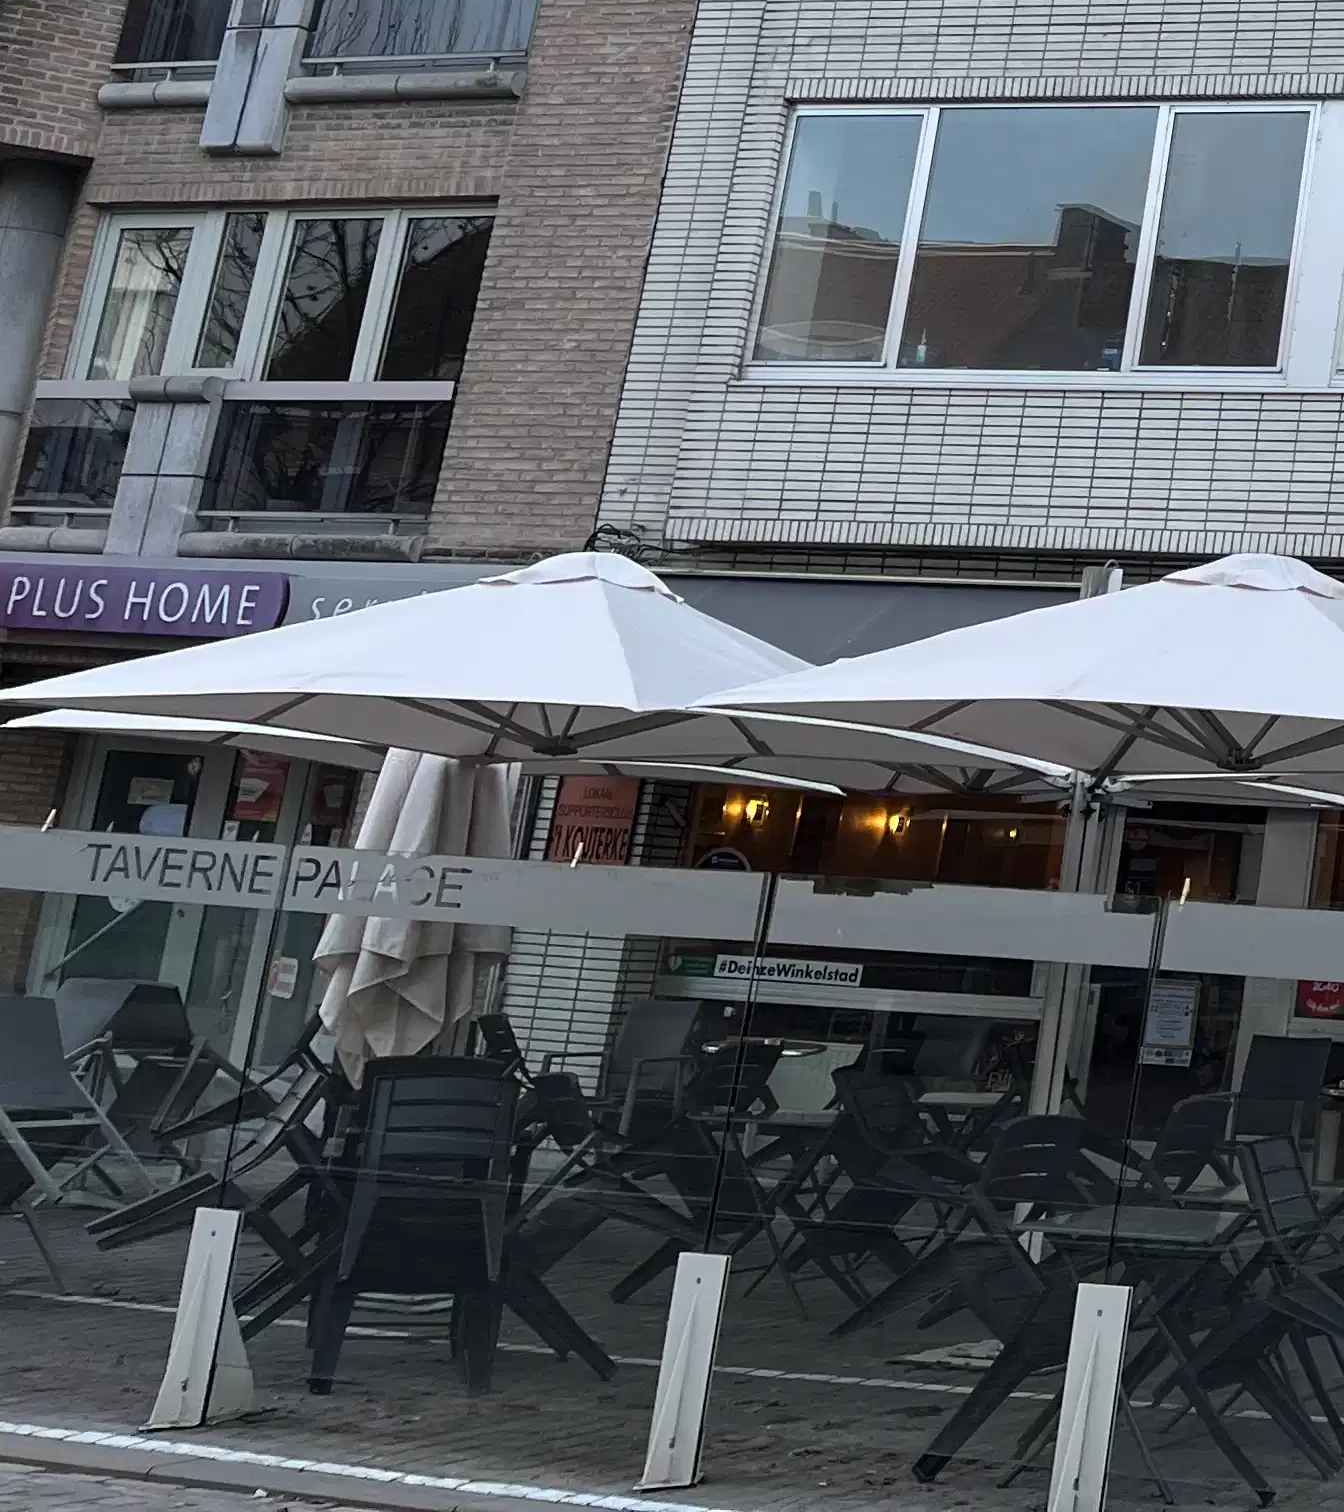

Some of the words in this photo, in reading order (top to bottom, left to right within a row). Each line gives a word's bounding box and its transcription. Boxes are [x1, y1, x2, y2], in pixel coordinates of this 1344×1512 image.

[6, 576, 109, 620] PLUS
[123, 581, 261, 626] HOME
[88, 843, 278, 896] TAVERNE
[292, 857, 473, 909] PALACE
[718, 959, 858, 983] #DeinzeWinkelstad
